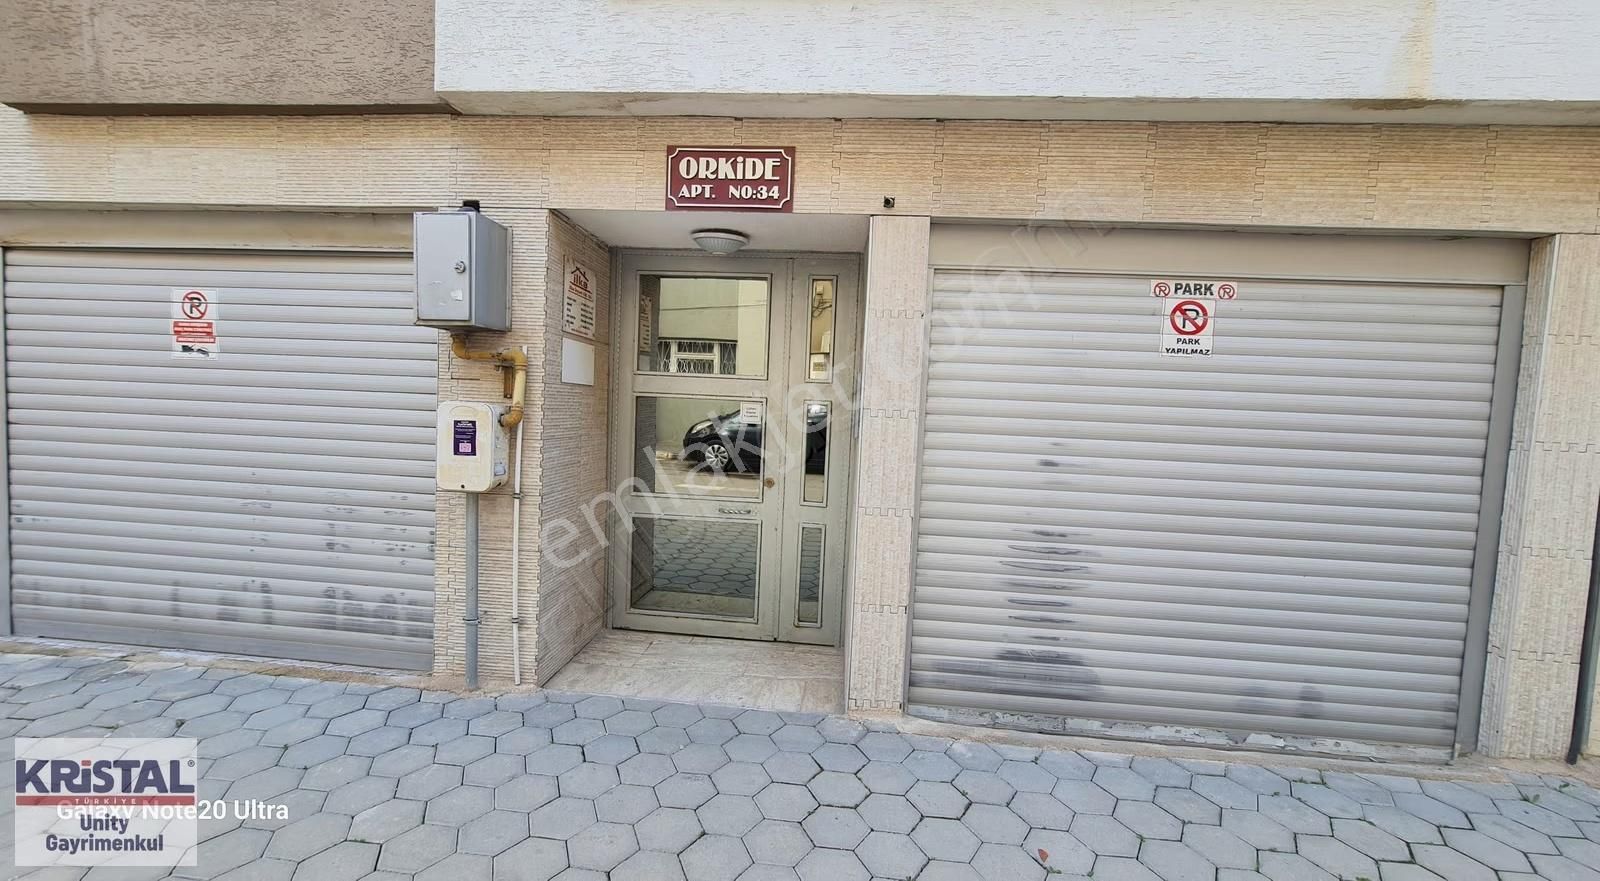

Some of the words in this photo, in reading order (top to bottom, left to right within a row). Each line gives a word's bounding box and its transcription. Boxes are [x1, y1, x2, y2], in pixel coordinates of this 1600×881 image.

[678, 184, 716, 198] APT.
[728, 185, 780, 199] NO:34
[1174, 283, 1215, 296] PARK
[1165, 347, 1210, 356] YAPILMAZ
